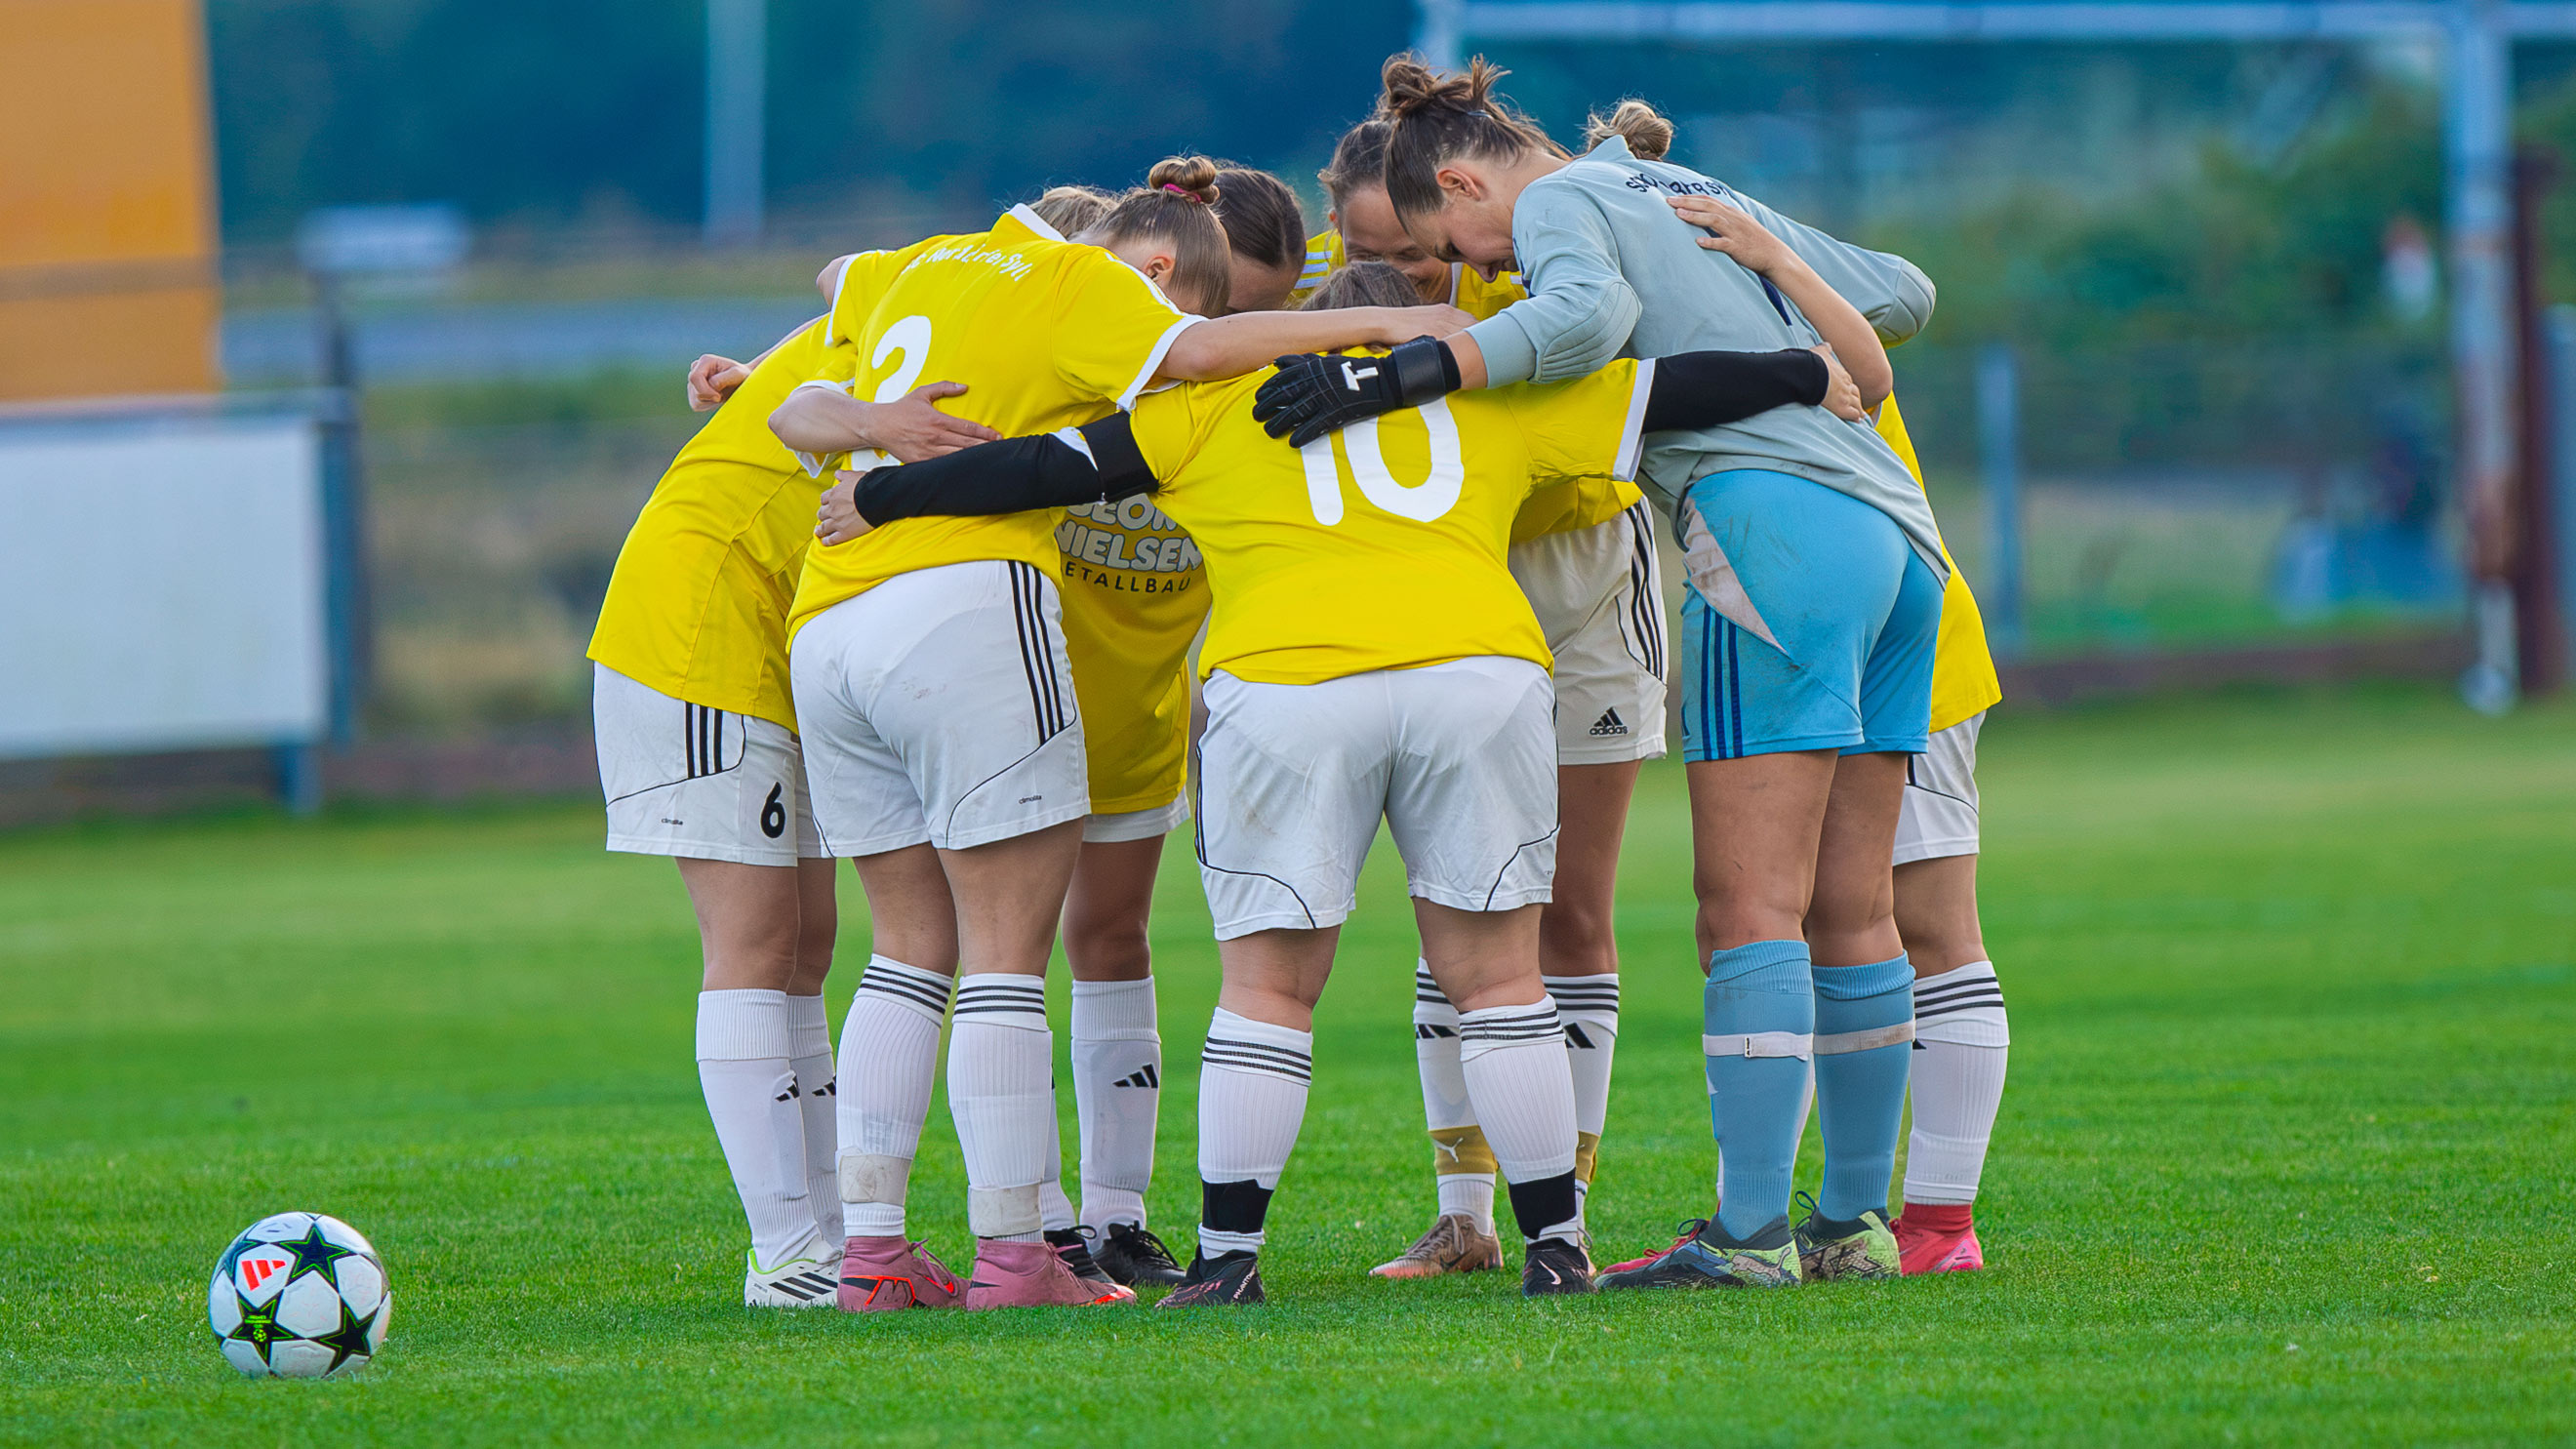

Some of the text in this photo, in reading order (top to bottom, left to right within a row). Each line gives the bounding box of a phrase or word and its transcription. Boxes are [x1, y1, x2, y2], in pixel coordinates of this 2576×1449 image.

[851, 314, 933, 472] 2
[1301, 397, 1465, 527] 10
[1054, 519, 1203, 573] NIELSEN
[1590, 725, 1629, 736] adidas
[760, 782, 786, 839] 6
